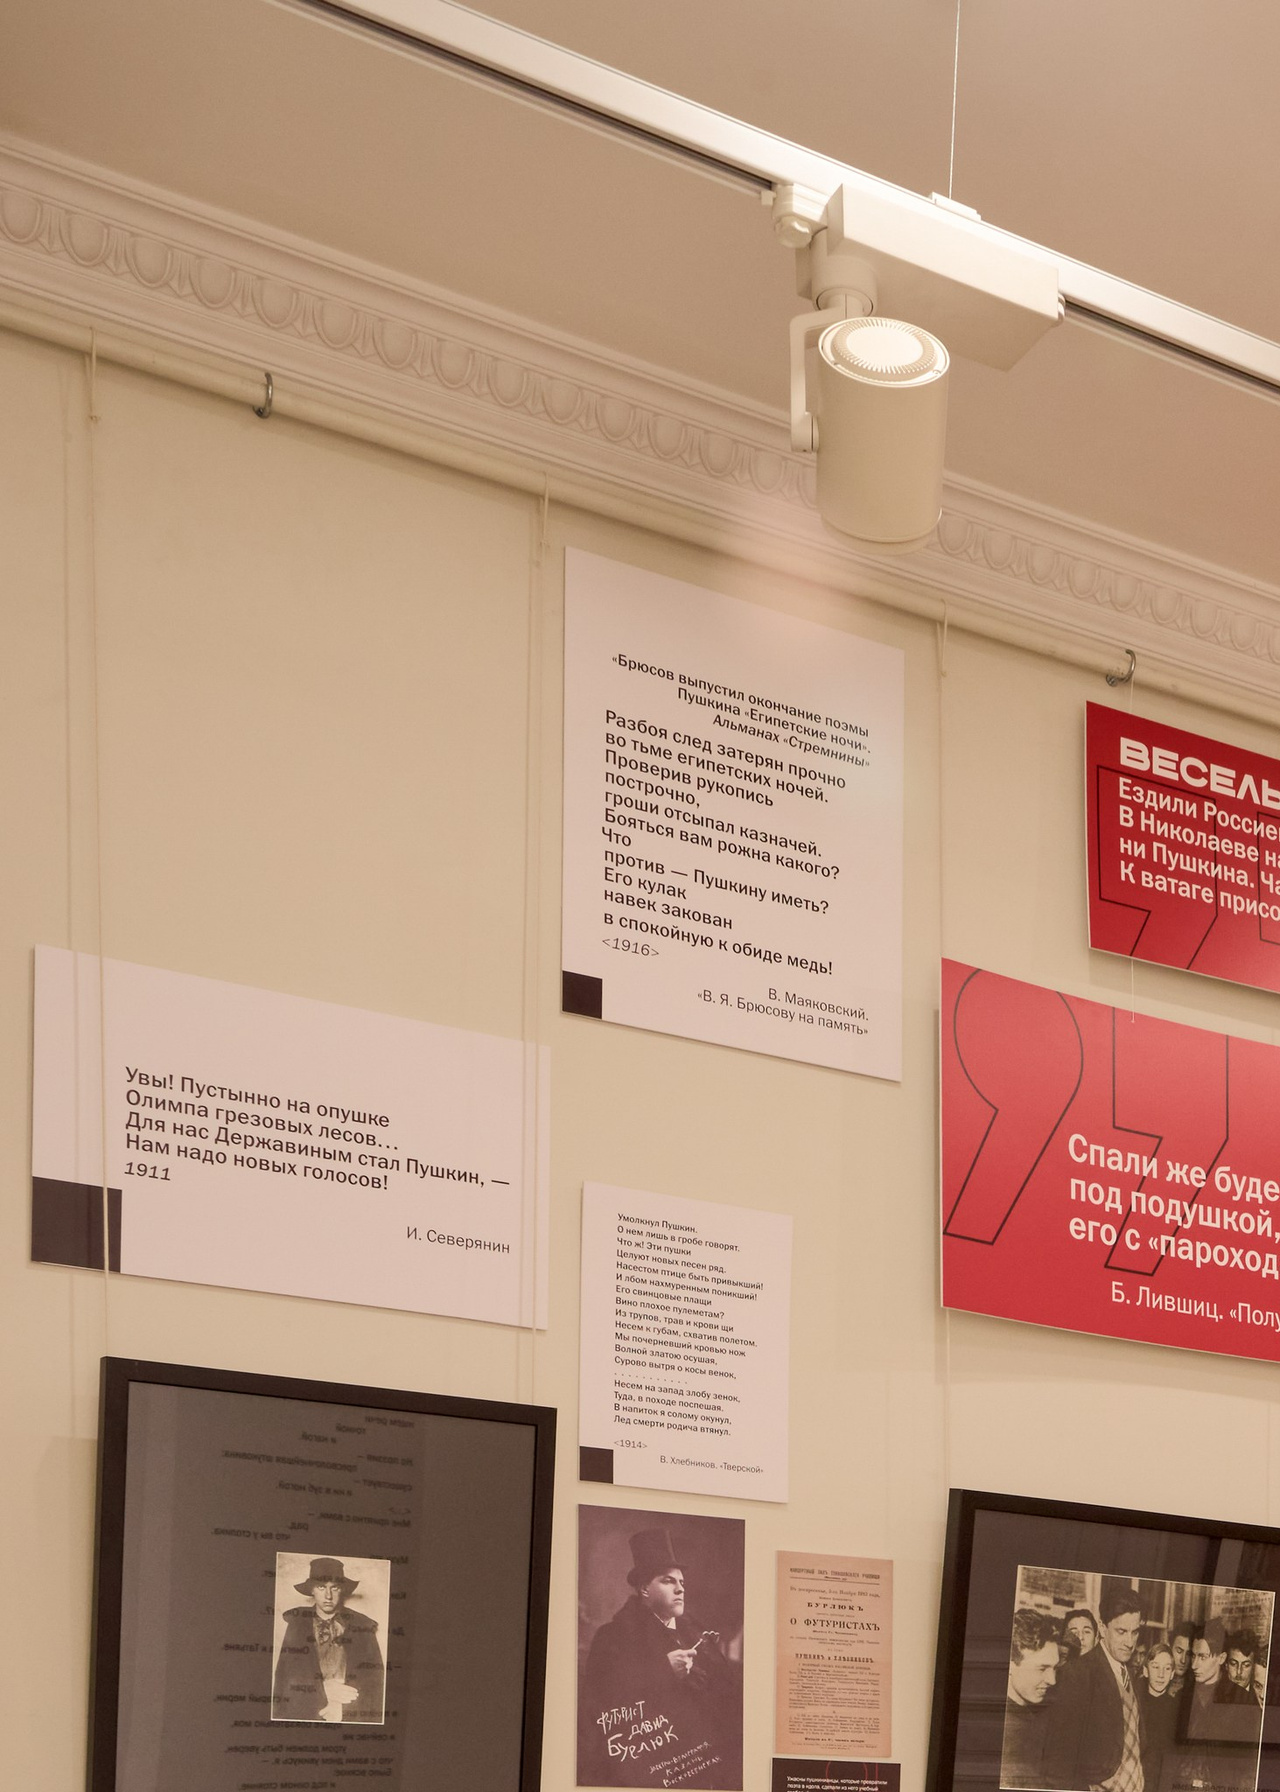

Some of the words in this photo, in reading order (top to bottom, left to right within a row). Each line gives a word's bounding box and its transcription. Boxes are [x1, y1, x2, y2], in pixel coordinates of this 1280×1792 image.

[677, 686, 741, 717] Пушкина
[678, 673, 745, 702] выпустил
[747, 694, 822, 725] окончание
[824, 716, 869, 738] поэмы
[712, 713, 780, 744] Альманах
[605, 709, 668, 741] Разбоя
[672, 731, 713, 756] след
[716, 743, 784, 773] затерян
[788, 763, 846, 789] прочно
[605, 748, 692, 785] Проверив
[696, 776, 774, 807] рукопись
[605, 771, 700, 809] построчно,
[1118, 776, 1198, 819] Ездили
[604, 866, 633, 887] Его
[637, 877, 687, 901] кулак
[1119, 859, 1136, 885] К
[1141, 870, 1215, 905] ватаге
[768, 987, 781, 1003] В.
[784, 991, 869, 1021] Маяковский.
[125, 1065, 174, 1091] Увы!
[180, 1076, 281, 1109] Пустынно
[287, 1098, 311, 1115] на
[316, 1104, 390, 1128] опушке
[125, 1088, 209, 1119] Олимпа
[215, 1107, 313, 1137] грезовых
[123, 1161, 171, 1182] 1911
[1068, 1133, 1159, 1180] Спали
[1164, 1159, 1207, 1189] же
[406, 1225, 422, 1241] И.
[426, 1228, 510, 1254] Северянин
[1068, 1217, 1117, 1247] его
[1124, 1227, 1141, 1252] с
[1111, 1280, 1131, 1305] Б.
[1135, 1285, 1224, 1323] Лившиц.
[790, 1618, 797, 1626] О
[804, 1618, 880, 1632] ФУТУРИСТАХЪ
